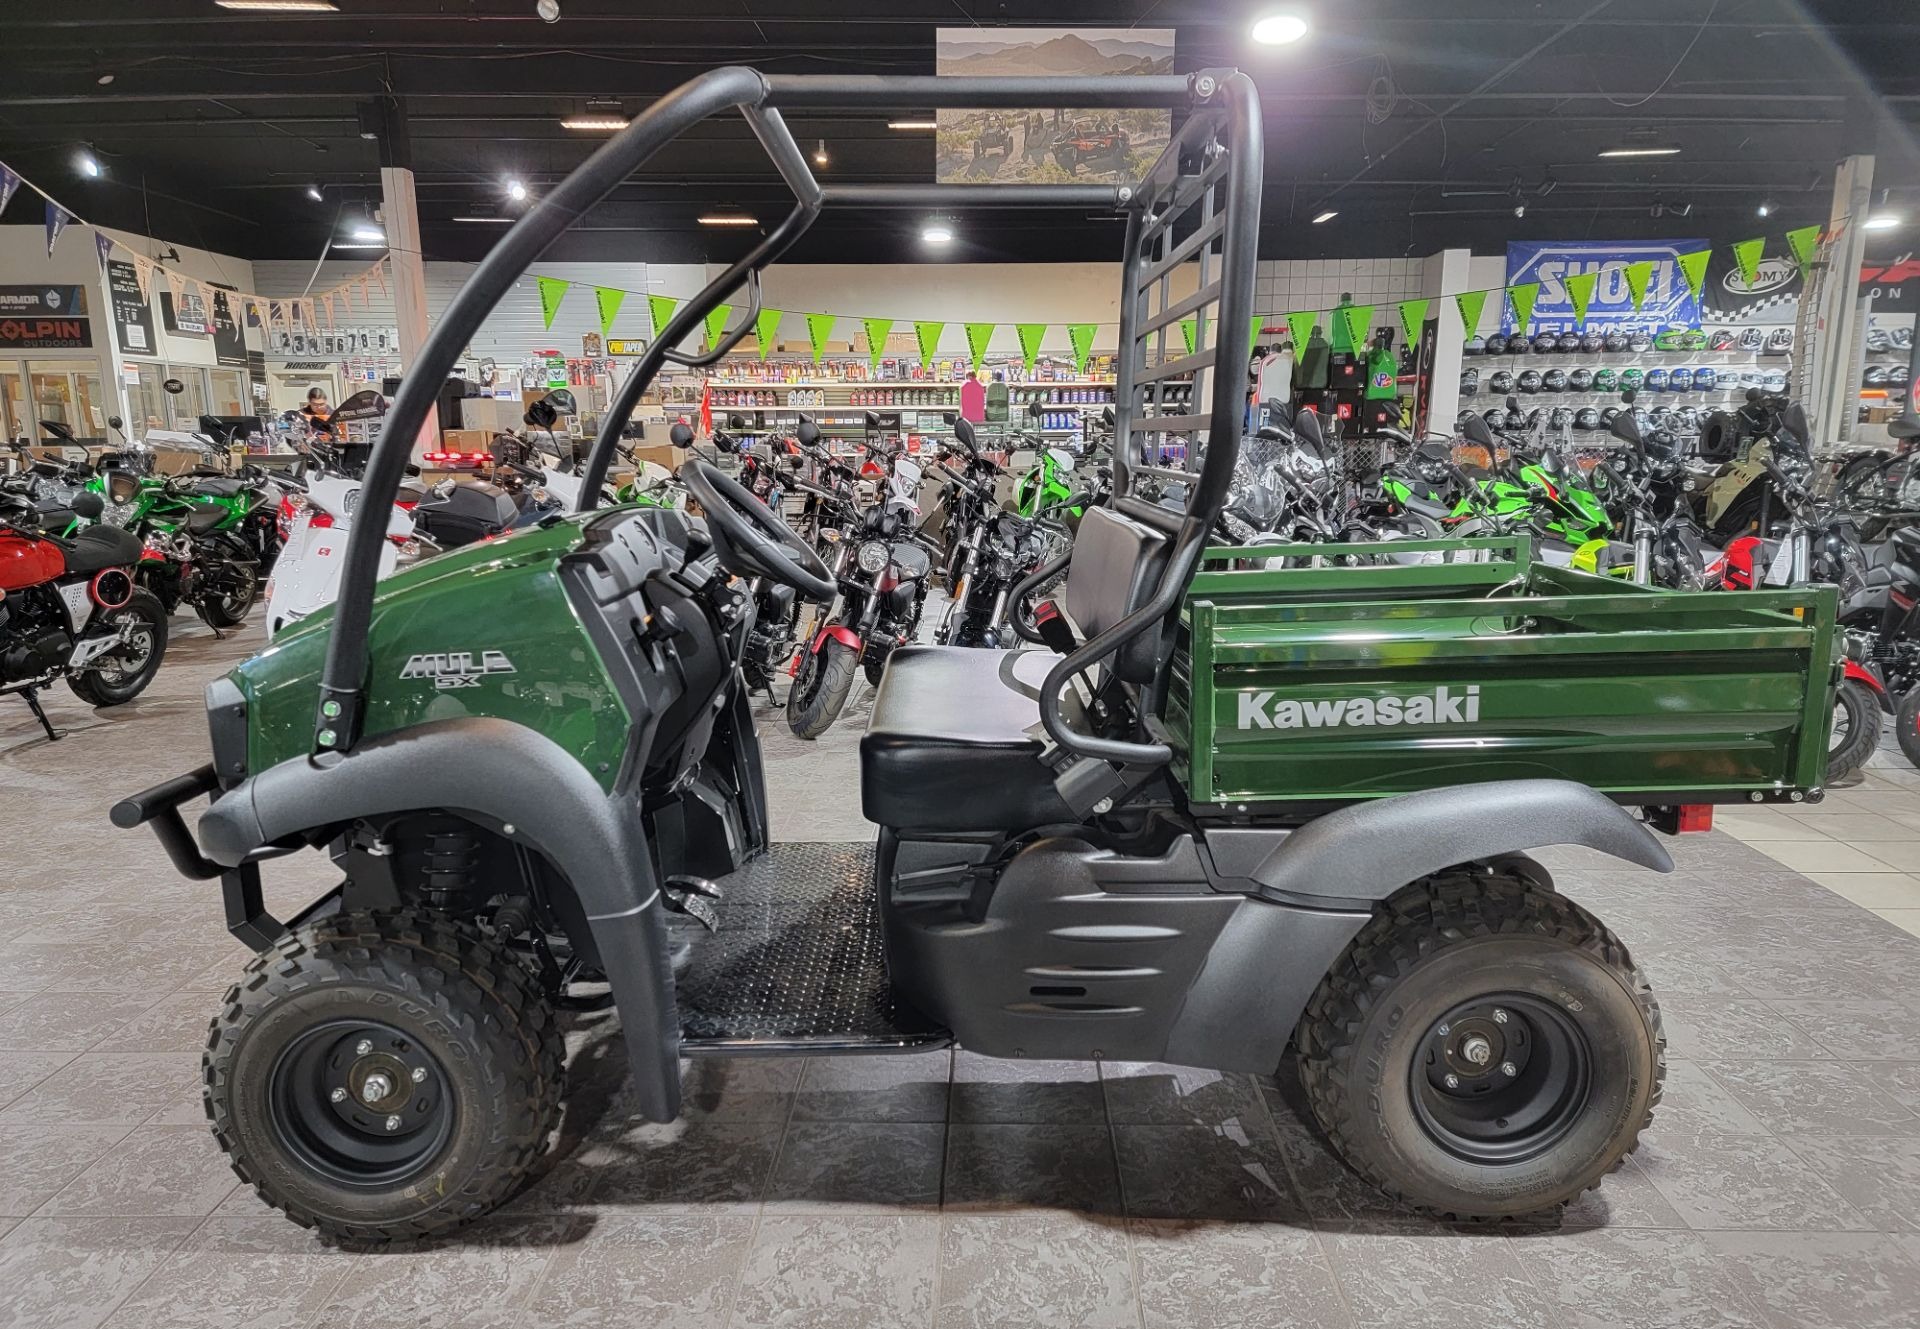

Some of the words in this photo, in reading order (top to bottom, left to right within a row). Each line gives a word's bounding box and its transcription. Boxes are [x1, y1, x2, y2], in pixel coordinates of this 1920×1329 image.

[1622, 267, 1638, 299] Kawasaki
[1679, 258, 1696, 292] Kawasaki
[1565, 280, 1581, 312] Kawasaki
[1345, 311, 1359, 344] Kawasaki
[1399, 304, 1412, 338] Kawasaki
[1457, 297, 1471, 329] Kawasaki
[1510, 321, 1690, 337] HELMETS
[399, 650, 517, 679] MULE
[435, 675, 482, 689] SX
[1238, 685, 1480, 730] Kawasaki
